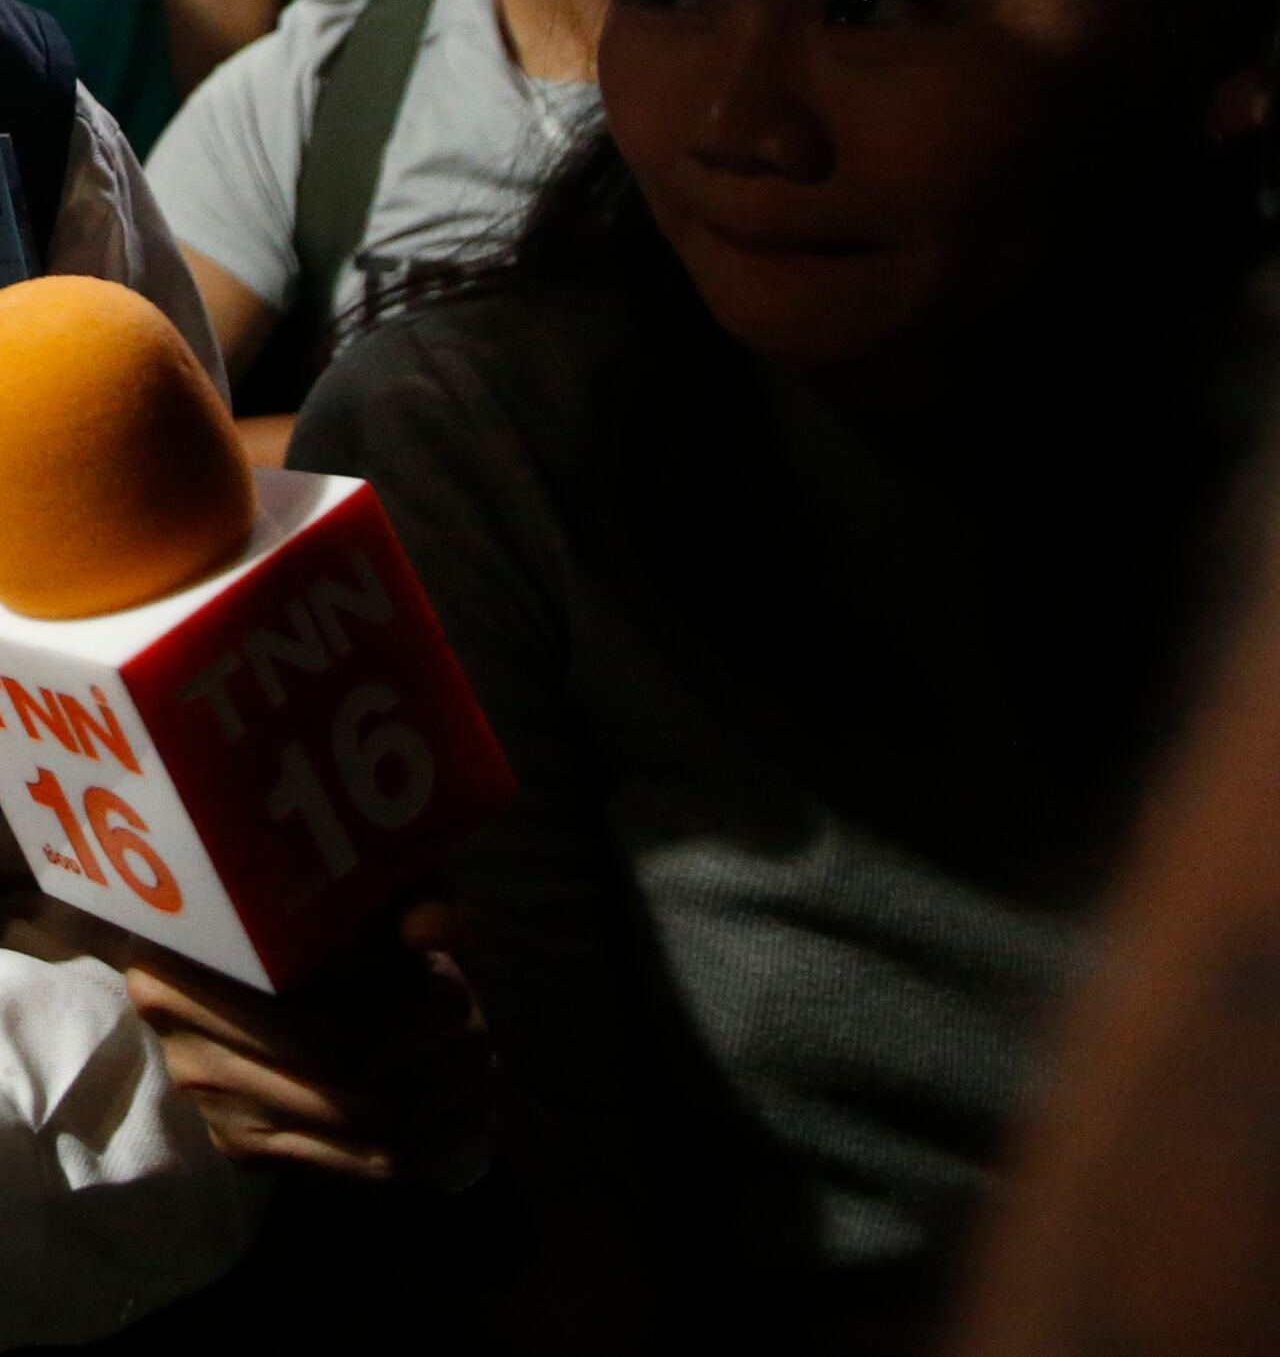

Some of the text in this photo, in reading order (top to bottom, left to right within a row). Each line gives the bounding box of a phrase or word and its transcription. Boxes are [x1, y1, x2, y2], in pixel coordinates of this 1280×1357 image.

[176, 548, 397, 742] TNN
[26, 766, 183, 916] 16
[264, 682, 435, 879] 16
